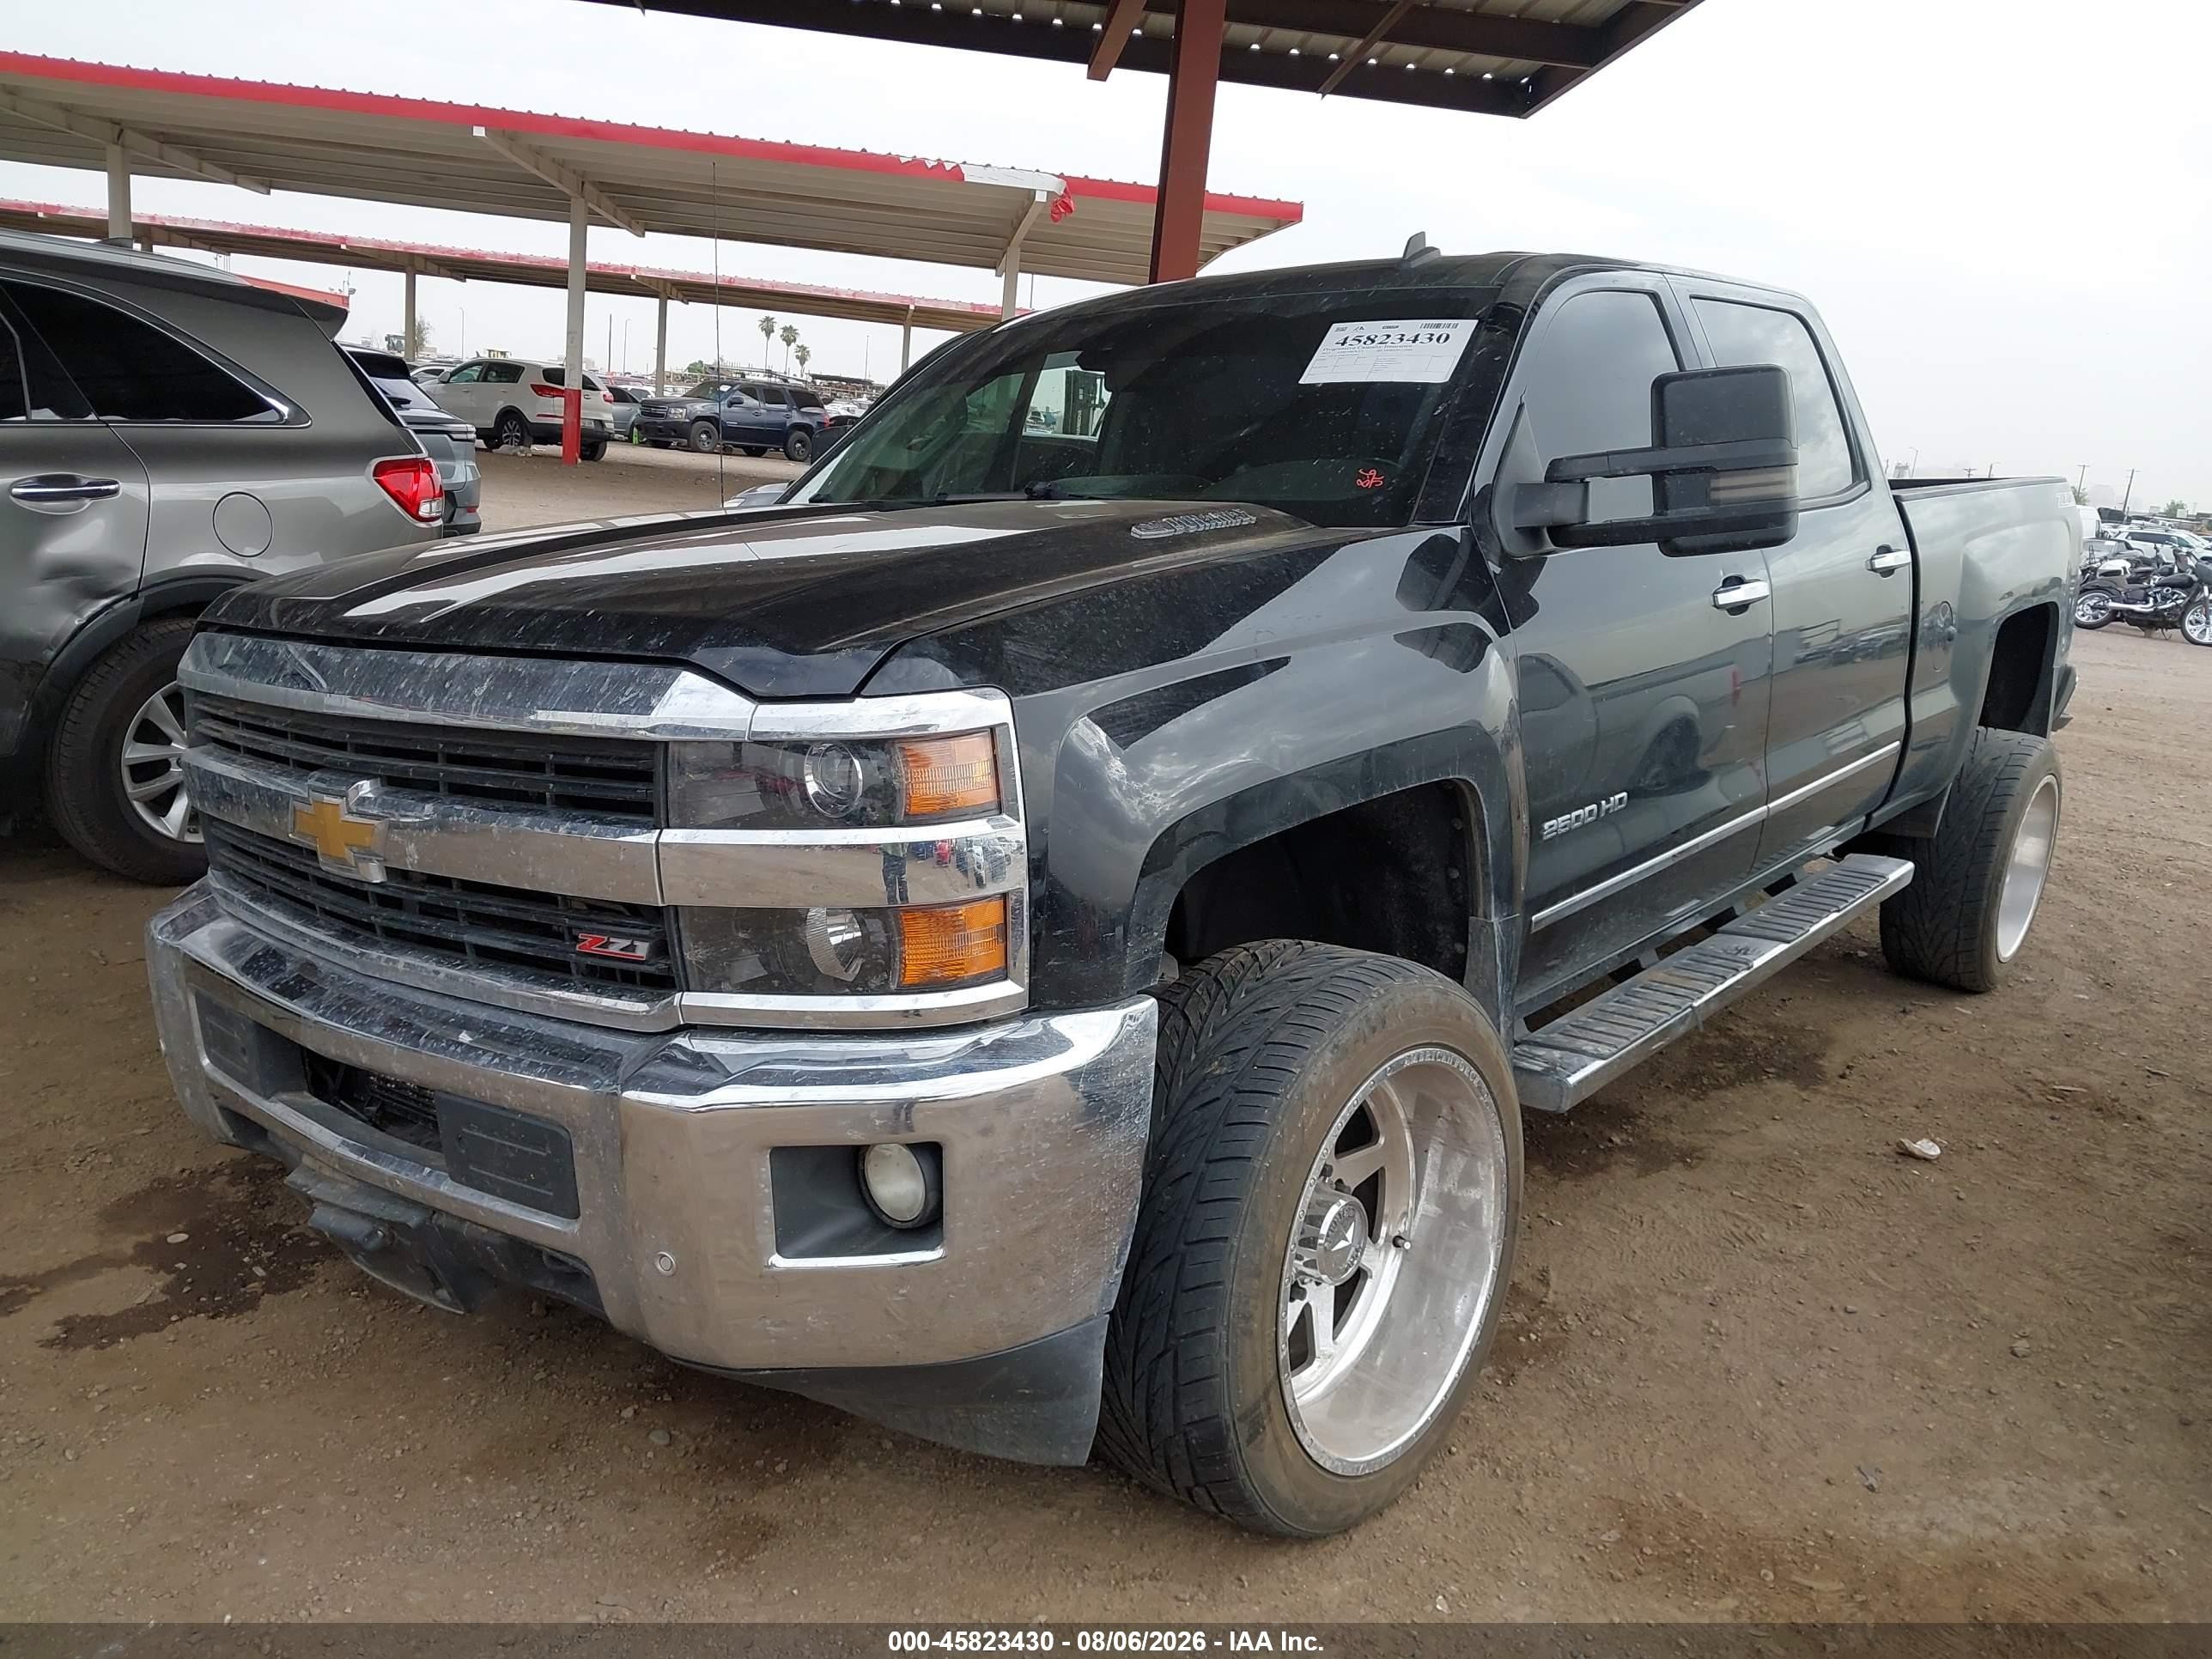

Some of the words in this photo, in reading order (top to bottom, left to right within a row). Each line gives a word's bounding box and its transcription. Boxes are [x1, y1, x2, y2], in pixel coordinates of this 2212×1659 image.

[1334, 332, 1450, 347] 45823430
[1543, 804, 1598, 841] 2500
[1599, 791, 1628, 818] HD
[575, 933, 650, 961] Z71
